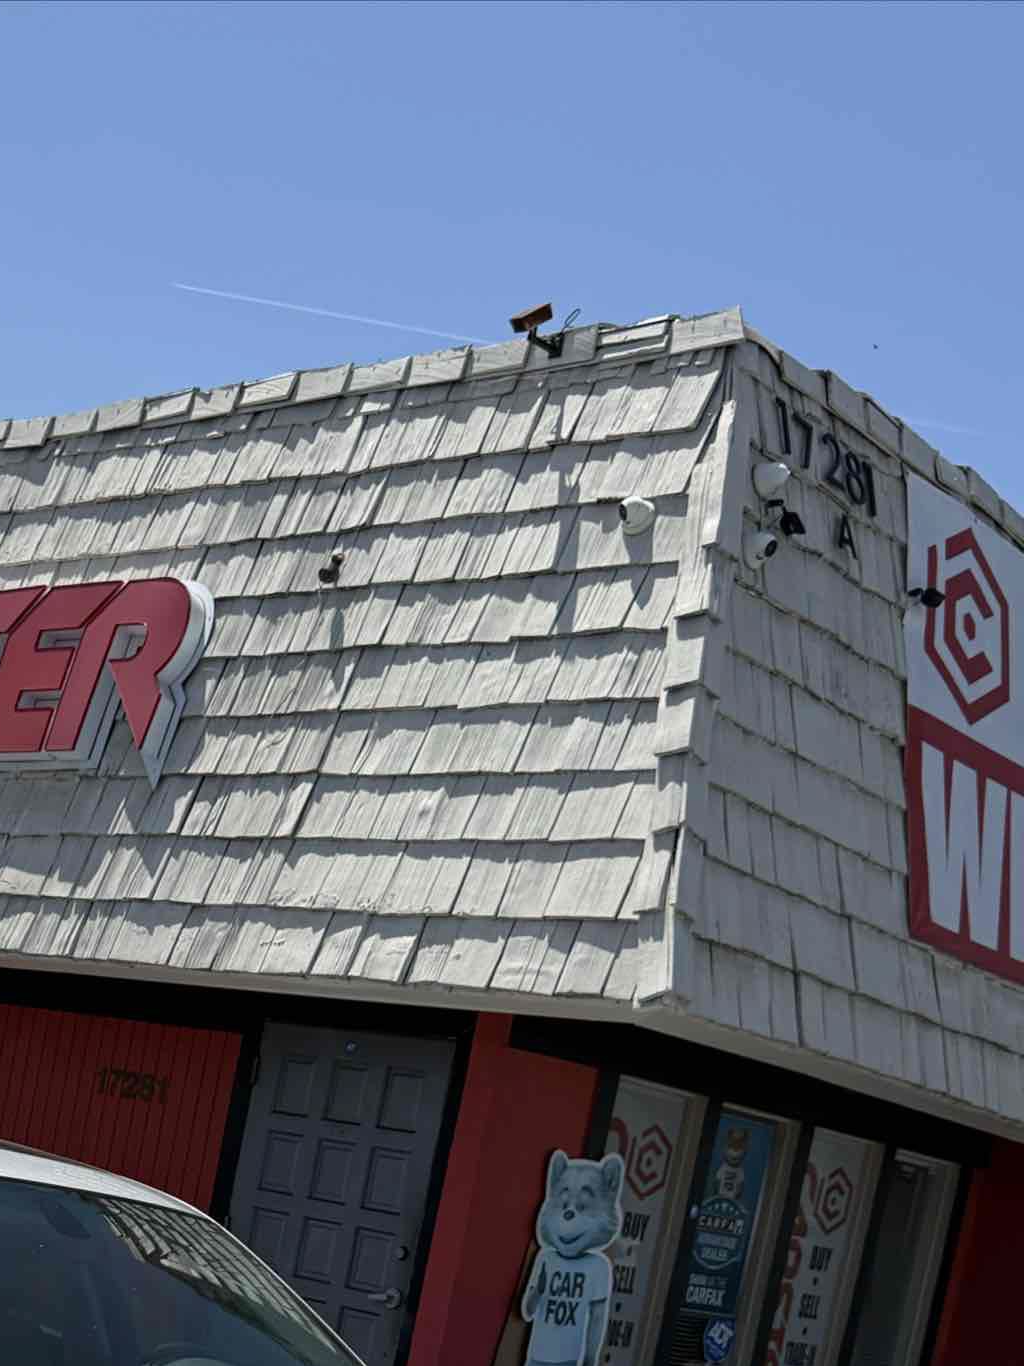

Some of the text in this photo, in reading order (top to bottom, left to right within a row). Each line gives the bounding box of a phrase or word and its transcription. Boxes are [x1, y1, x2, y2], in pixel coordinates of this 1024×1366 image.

[776, 396, 876, 517] 17281
[838, 513, 857, 560] A
[623, 1212, 650, 1241] BUY
[809, 1245, 833, 1272] BUY
[549, 1271, 586, 1298] CAR
[612, 1265, 636, 1294] SELL
[685, 1286, 727, 1307] CARFAX
[799, 1293, 821, 1319] SELL
[544, 1299, 579, 1327] FOX
